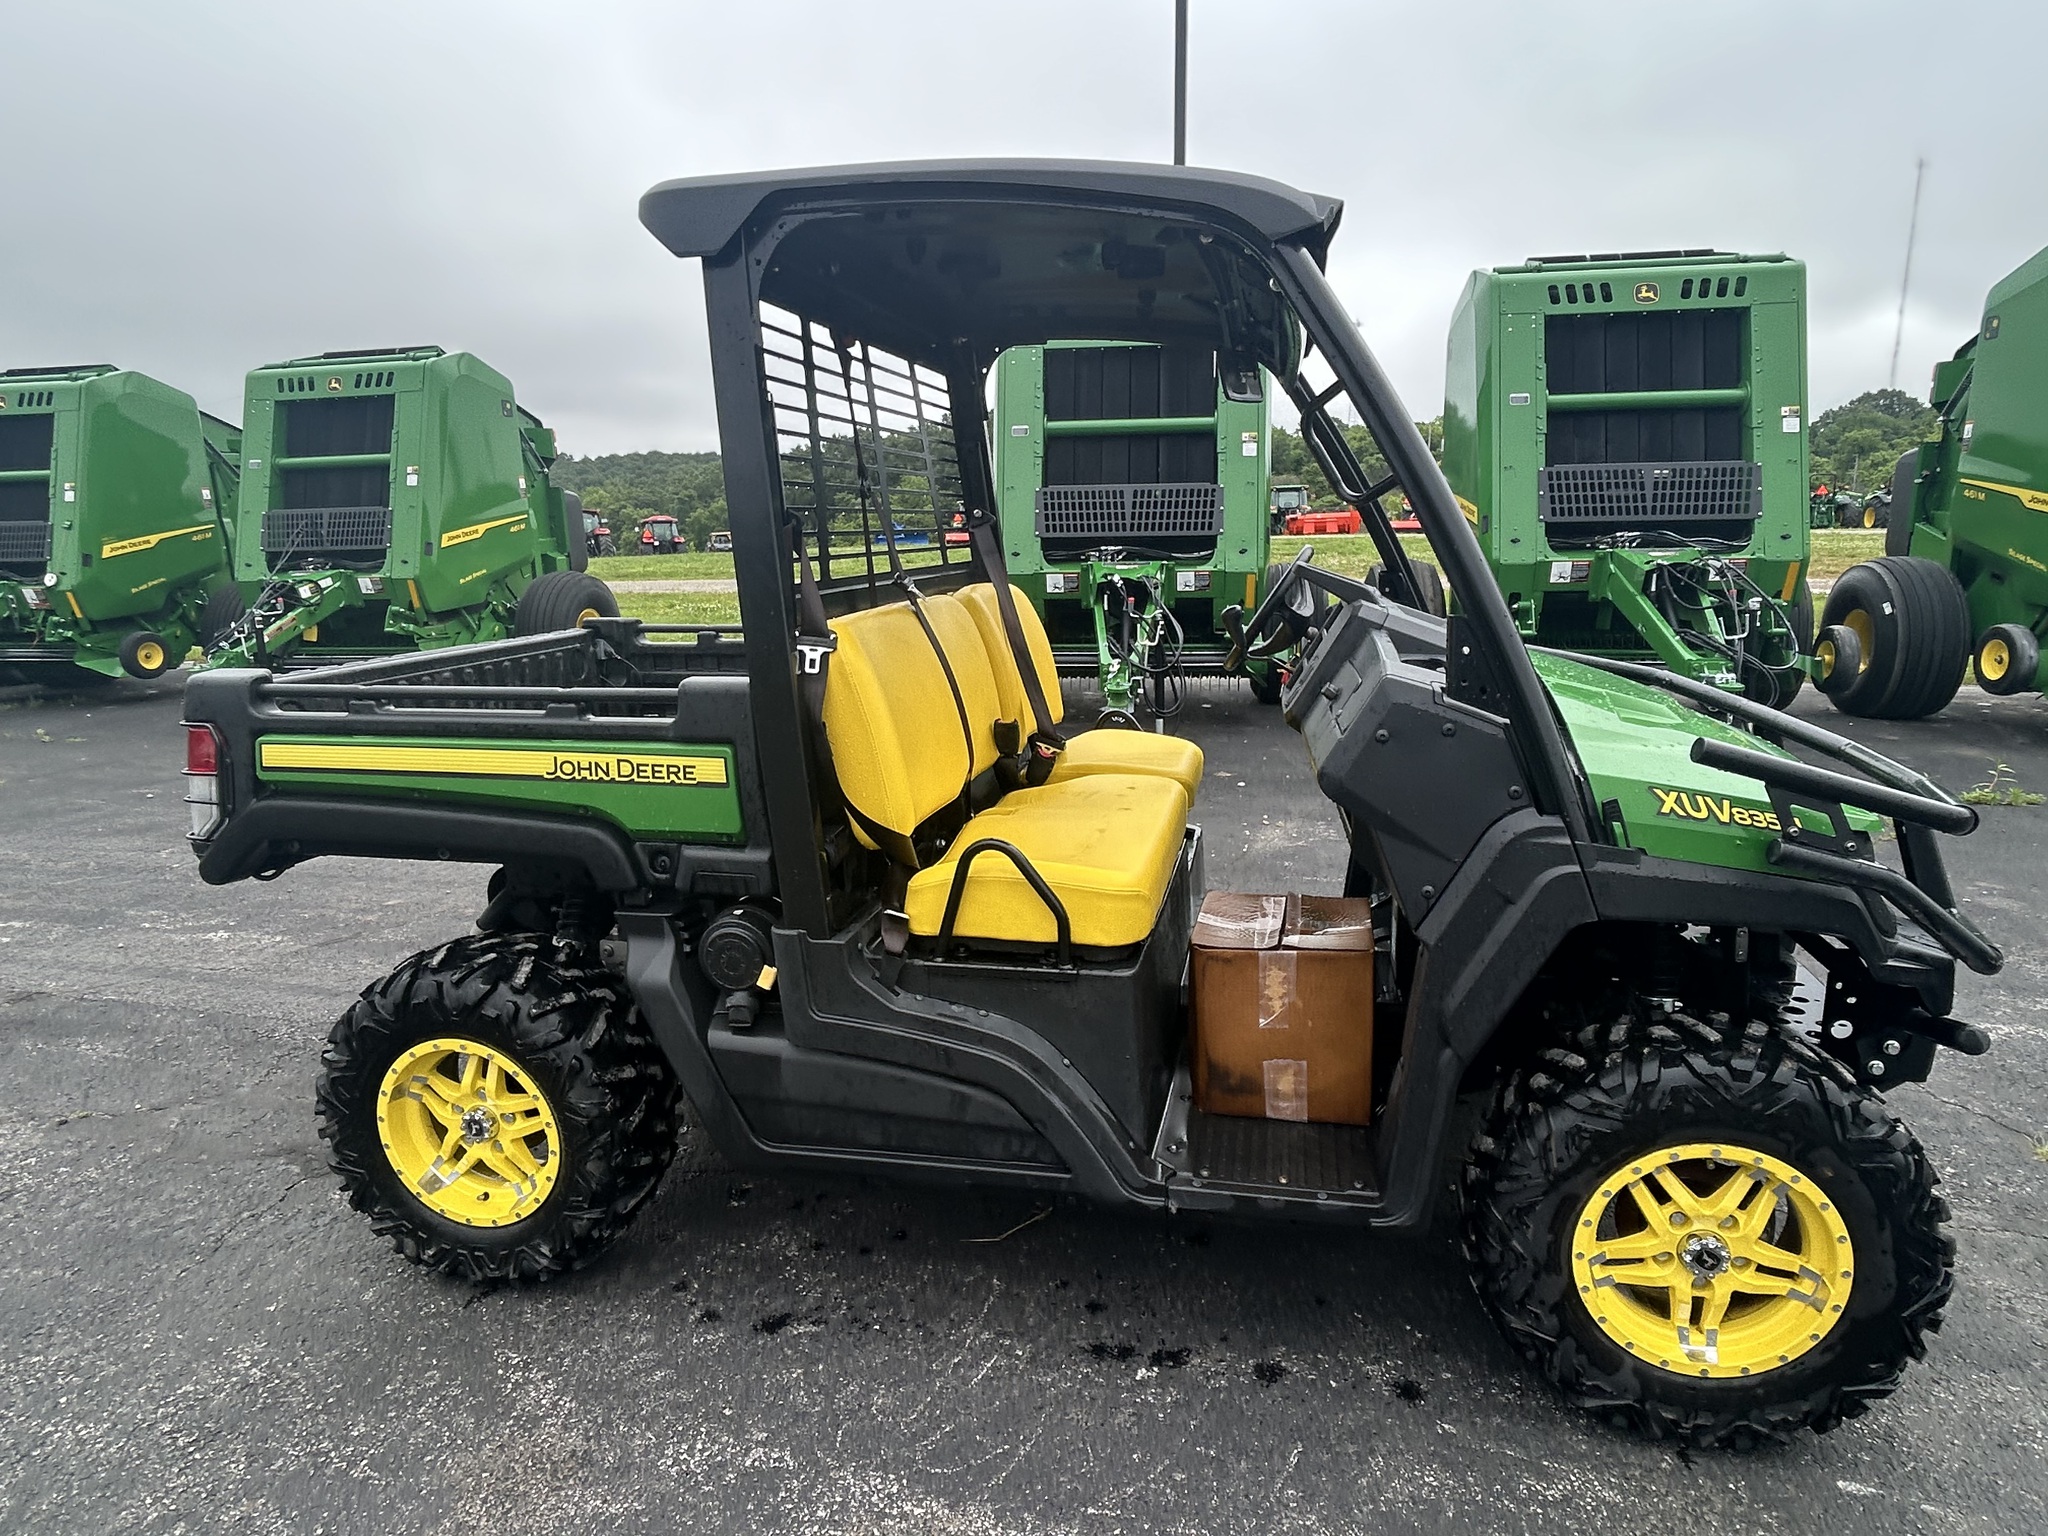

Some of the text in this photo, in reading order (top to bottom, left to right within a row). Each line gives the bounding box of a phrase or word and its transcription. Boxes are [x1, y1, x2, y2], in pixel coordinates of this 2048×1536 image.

[546, 756, 697, 781] JOHN DEERE
[1652, 787, 1803, 831] XUV835
